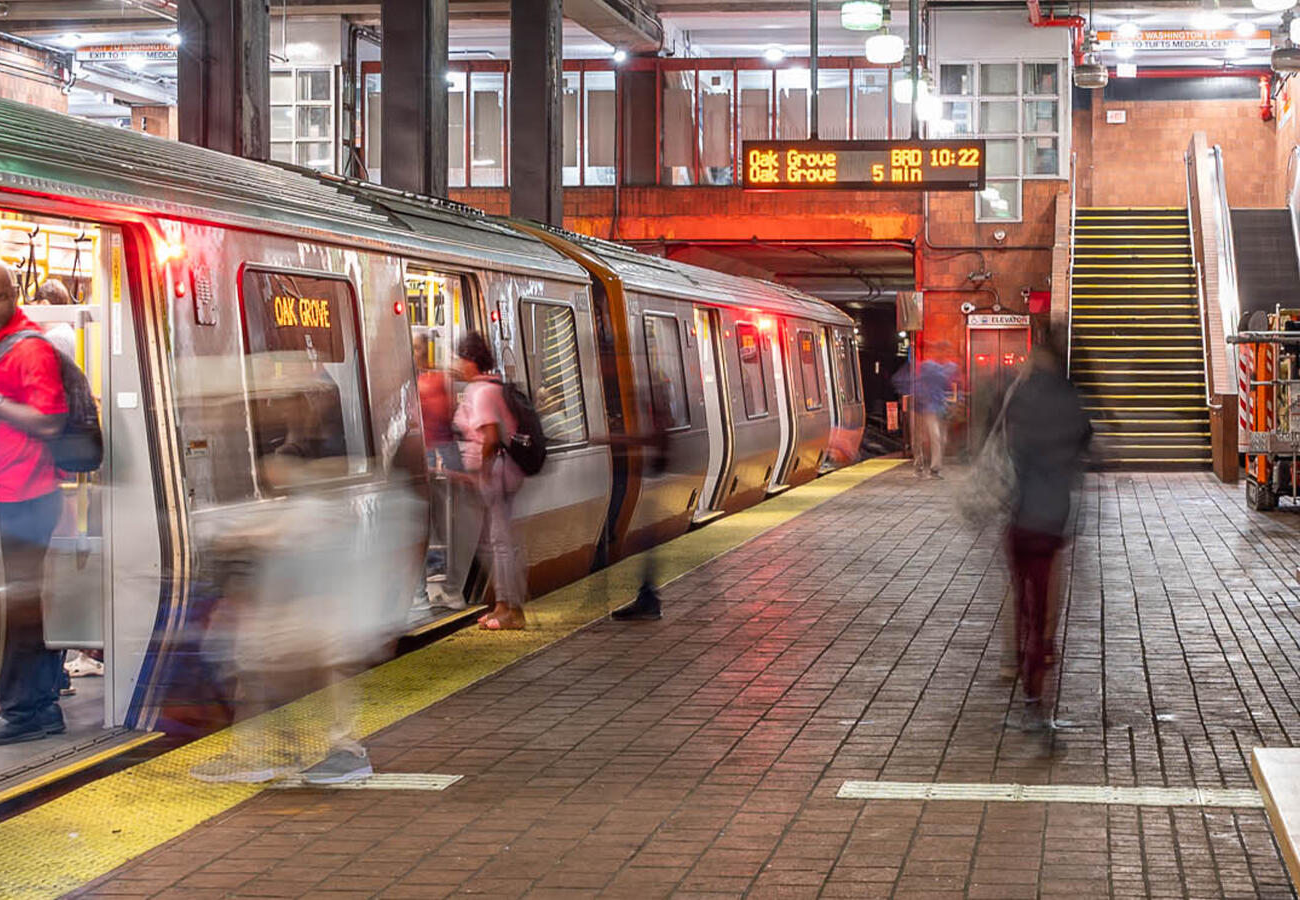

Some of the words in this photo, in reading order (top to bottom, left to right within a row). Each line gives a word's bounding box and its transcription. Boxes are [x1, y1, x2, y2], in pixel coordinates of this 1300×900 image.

[1146, 31, 1204, 40] WASHINGTON
[749, 150, 779, 167] Oak
[786, 150, 836, 167] Grove
[891, 149, 922, 166] BRD
[930, 148, 979, 166] 10:22
[749, 165, 779, 182] Oak
[786, 165, 836, 182] Grove
[872, 164, 884, 182] 5
[891, 165, 922, 182] min
[274, 296, 298, 326] OAK
[299, 298, 331, 328] GROVE
